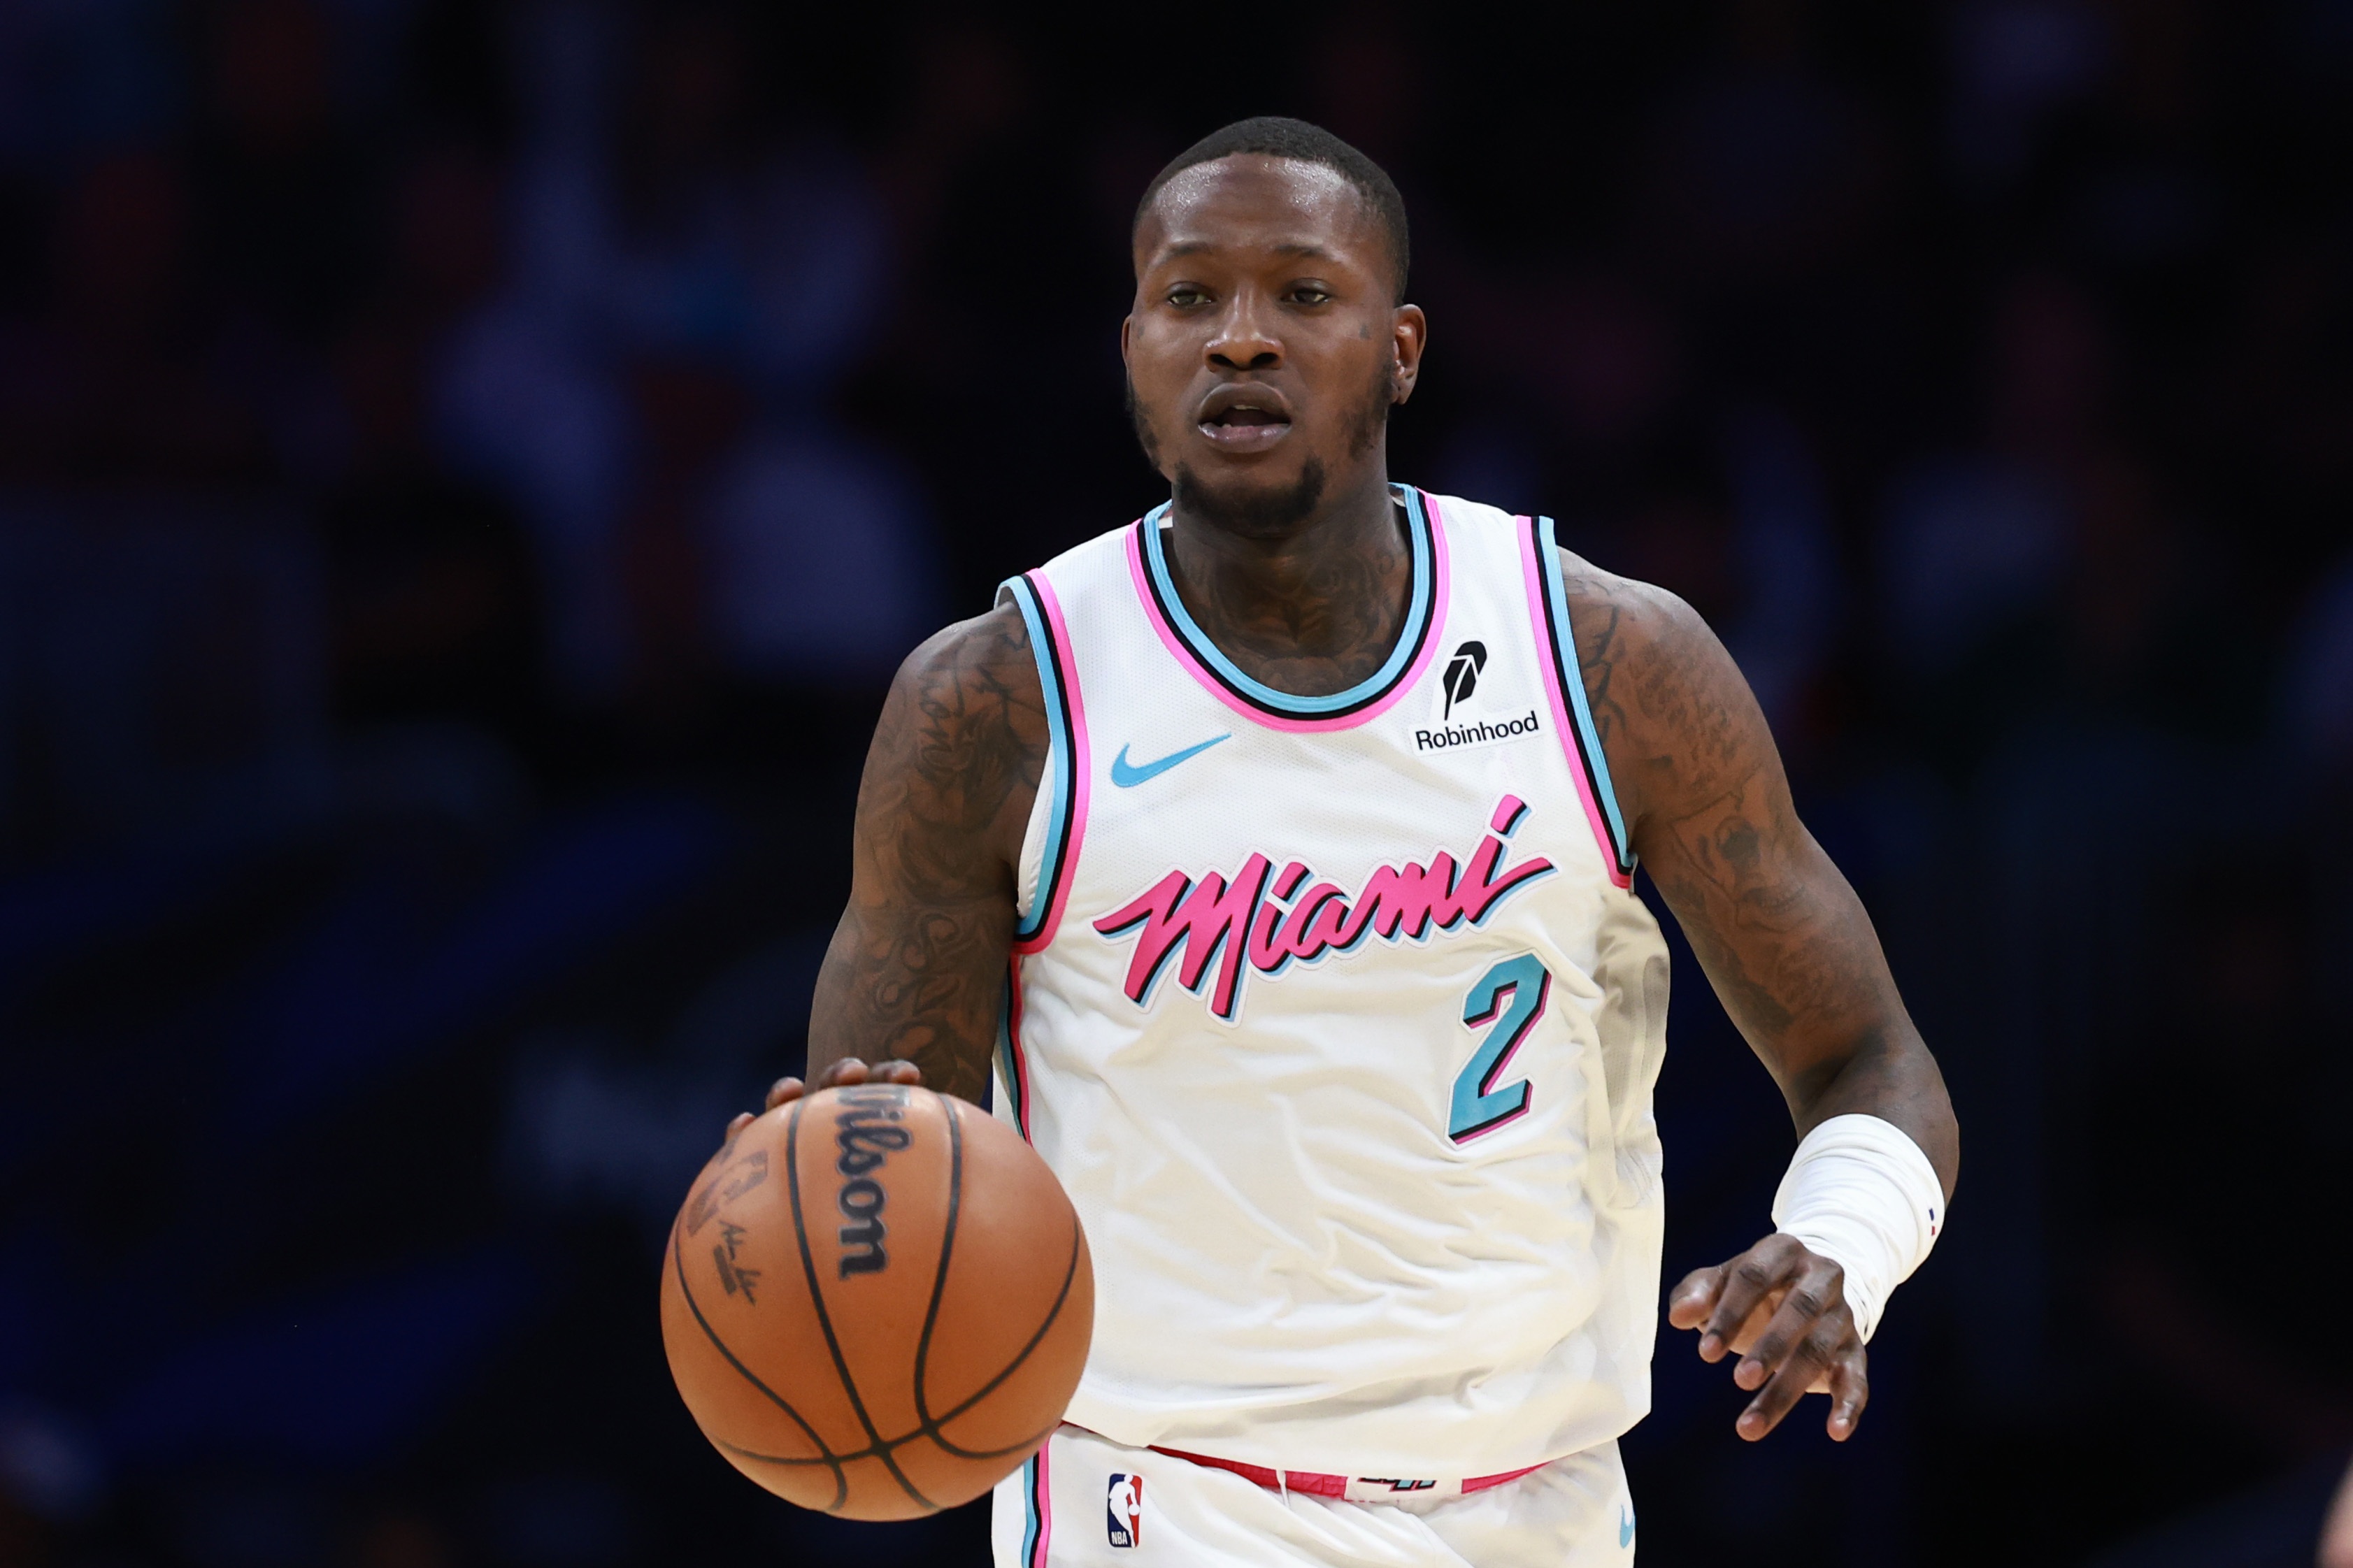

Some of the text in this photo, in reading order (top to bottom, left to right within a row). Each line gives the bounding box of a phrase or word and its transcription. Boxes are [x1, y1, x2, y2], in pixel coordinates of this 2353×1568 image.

[1415, 710, 1540, 751] Robinhood
[1092, 793, 1558, 1021] Miami
[1448, 952, 1552, 1146] 2
[1110, 1531, 1128, 1546] NBA
